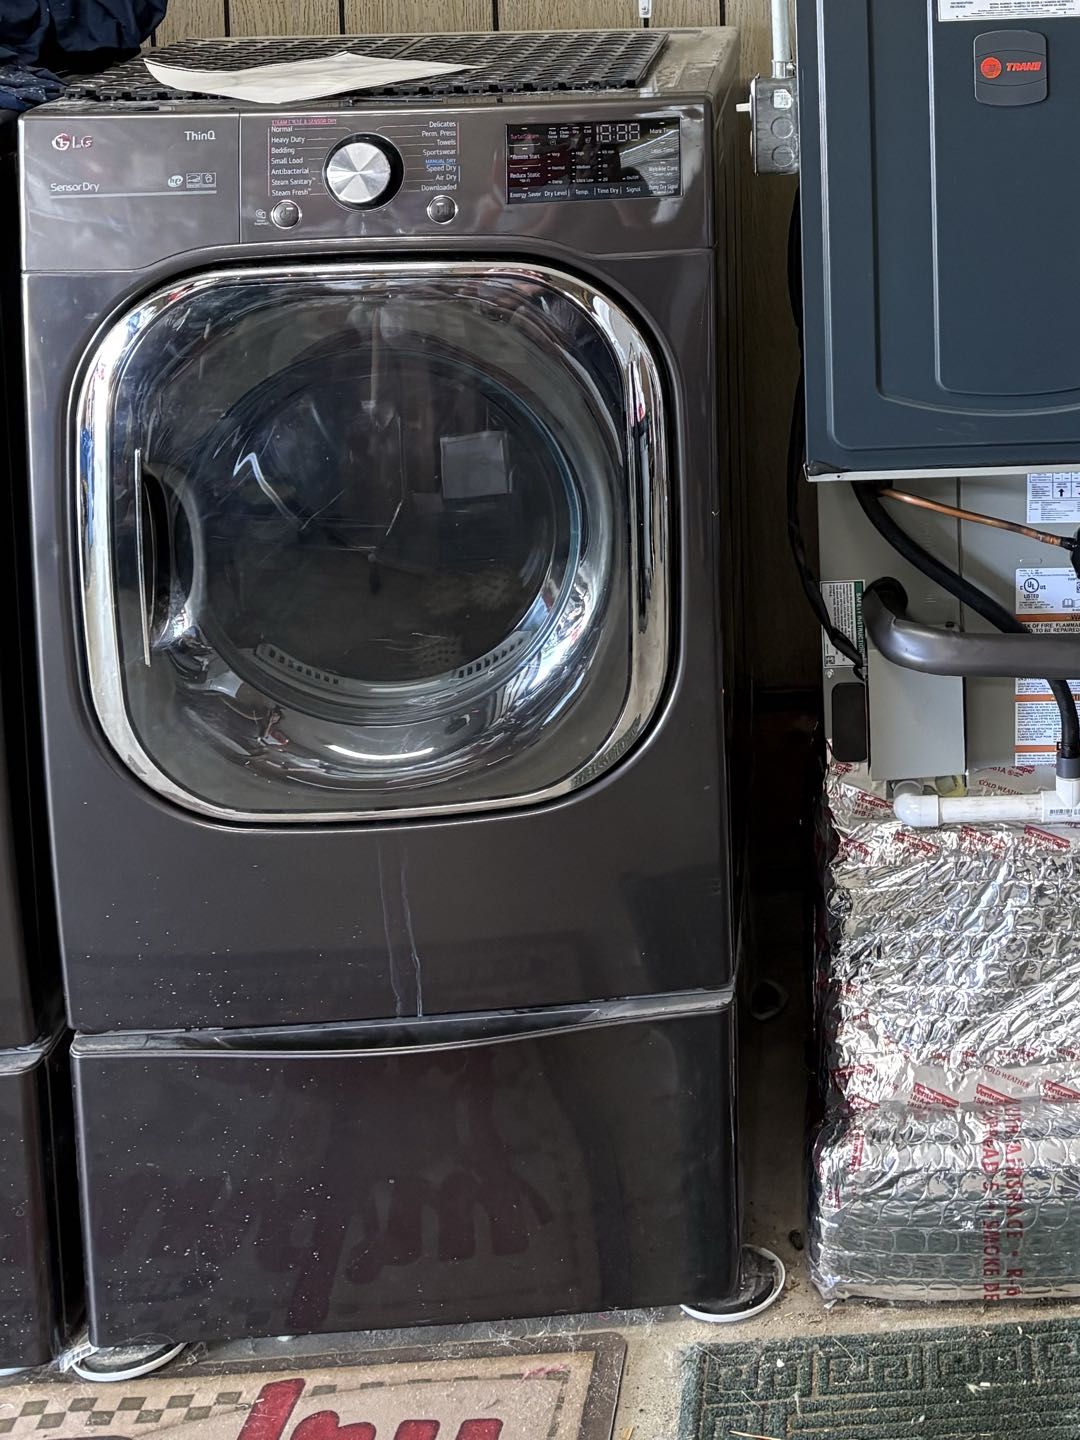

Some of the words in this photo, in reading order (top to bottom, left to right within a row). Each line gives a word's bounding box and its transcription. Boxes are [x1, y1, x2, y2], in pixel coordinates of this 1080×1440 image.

[1006, 61, 1041, 72] TRANE
[184, 130, 216, 141] ThinQ
[291, 136, 306, 144] Duty
[271, 147, 295, 155] Bedding
[983, 1219, 1000, 1276] SMOKE
